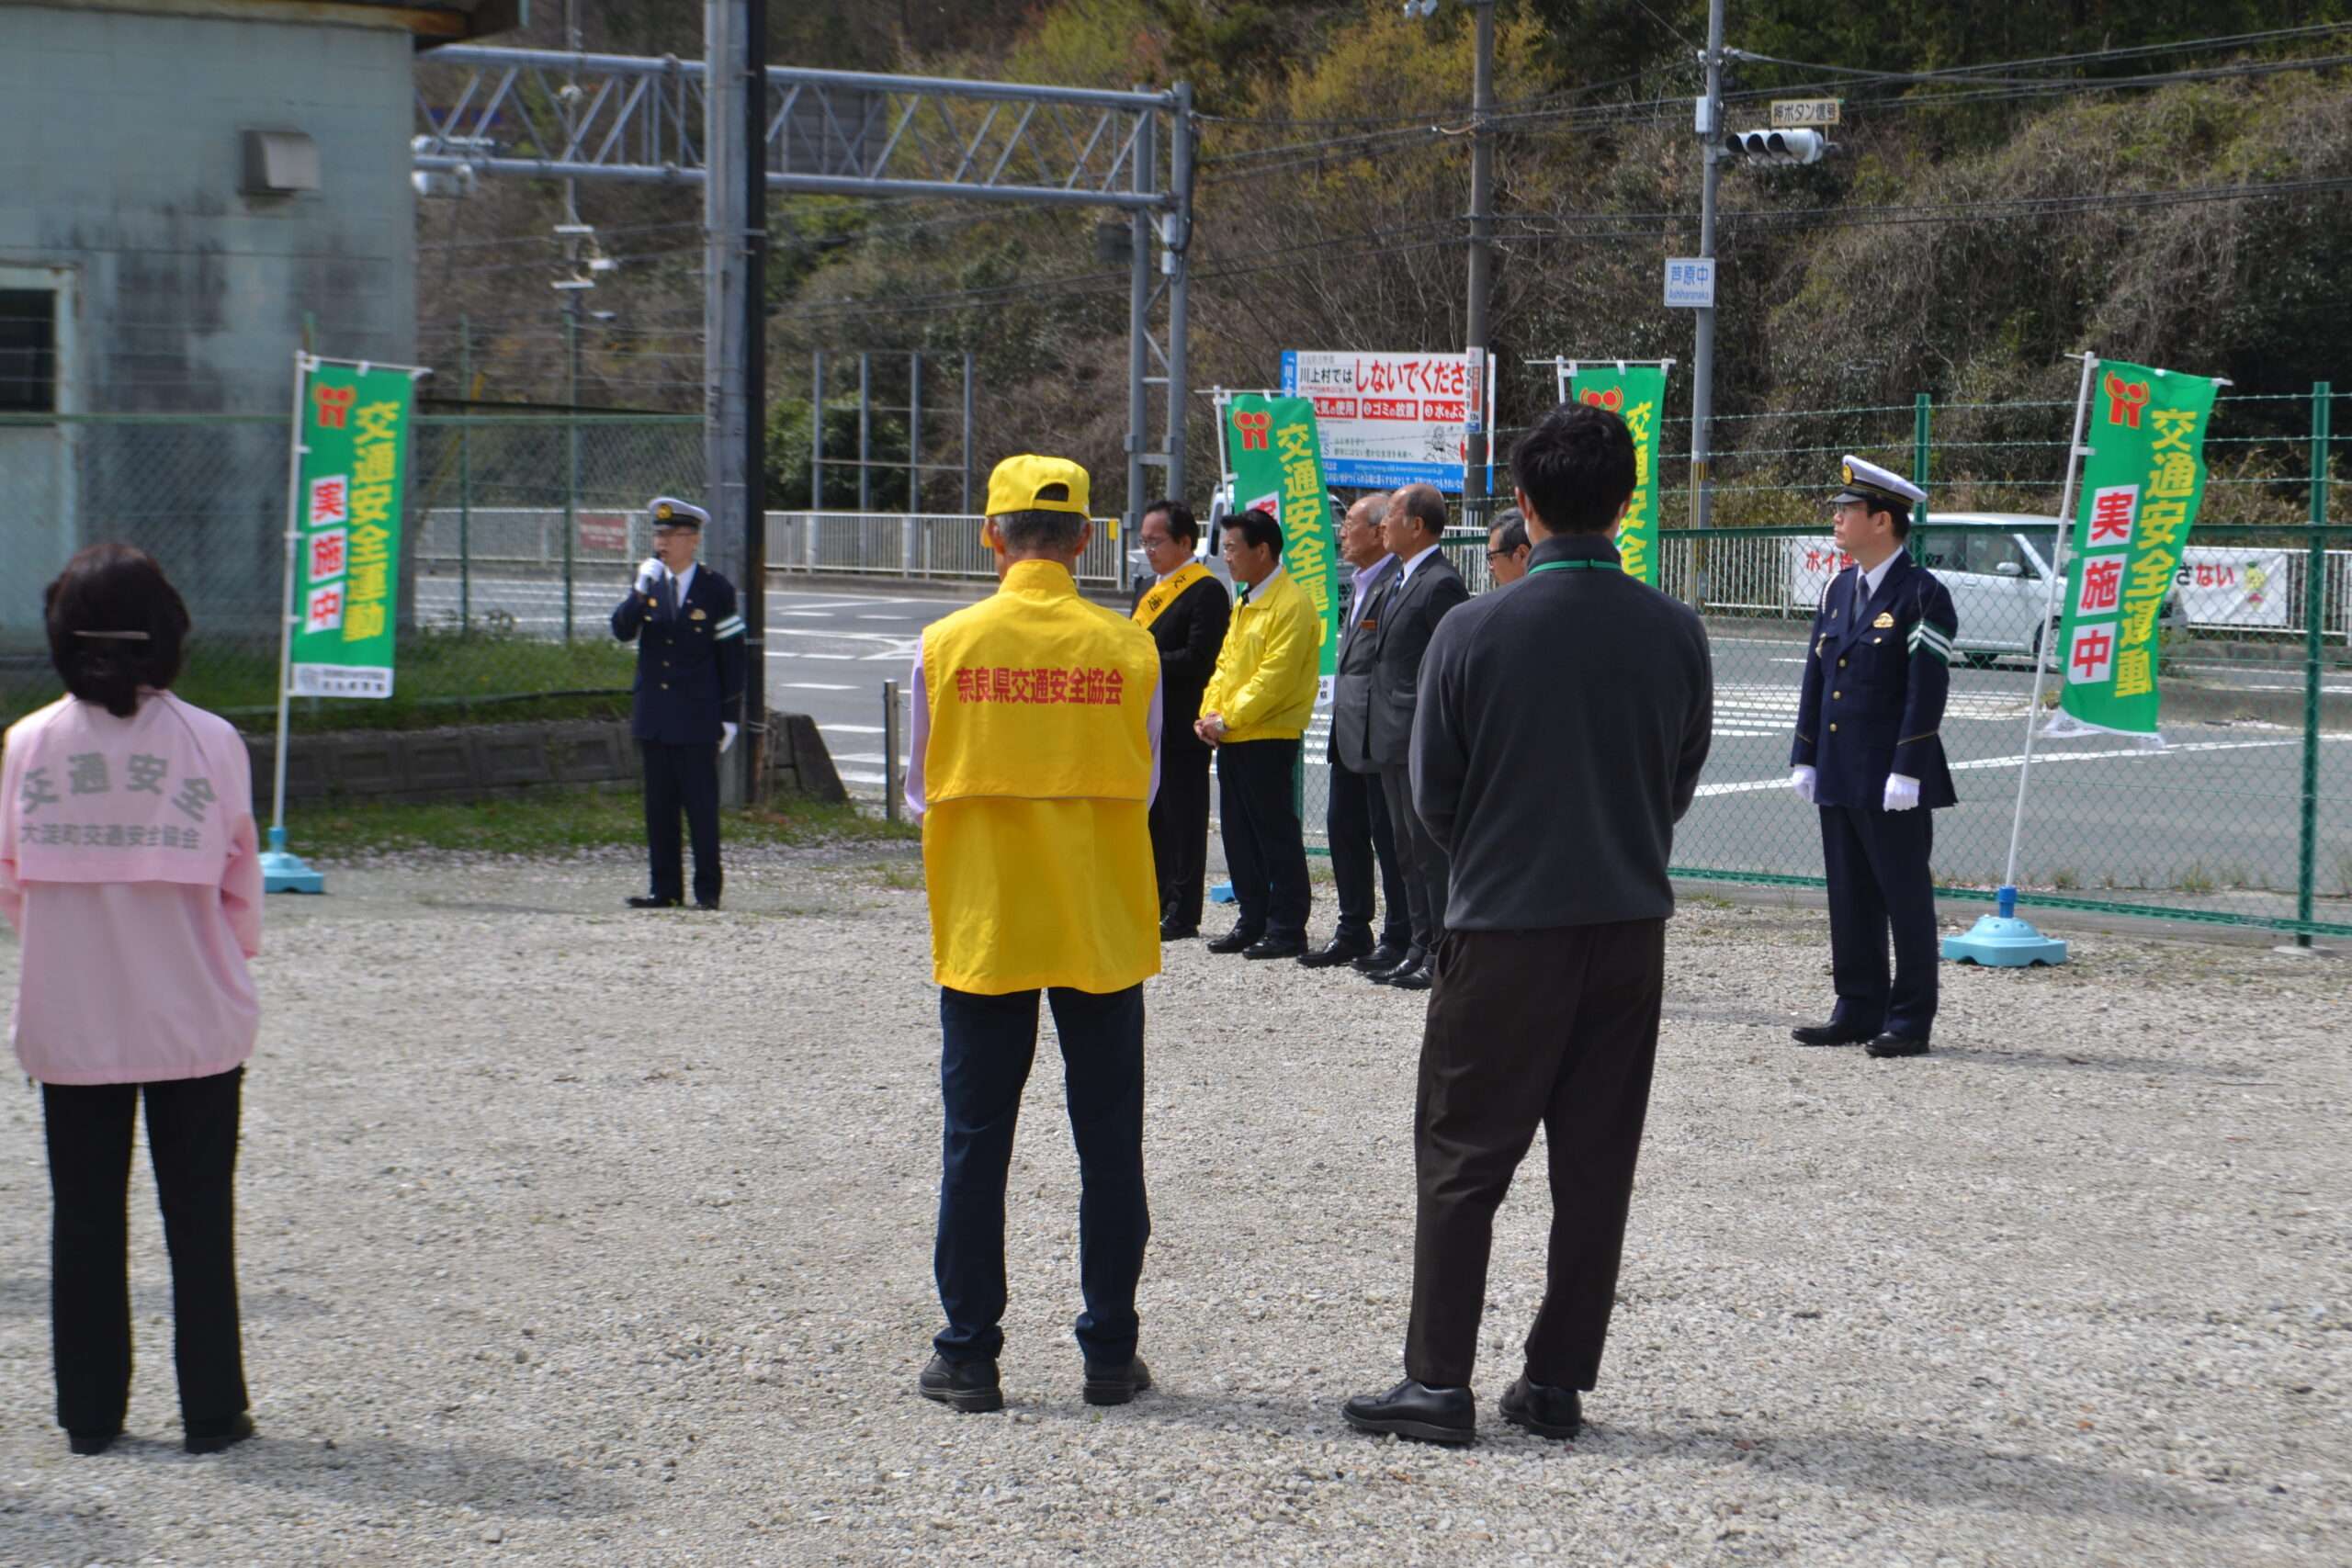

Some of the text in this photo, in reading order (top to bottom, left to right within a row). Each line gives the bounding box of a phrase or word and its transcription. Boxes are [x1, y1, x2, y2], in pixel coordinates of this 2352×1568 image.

[1774, 102, 1836, 122] 押ボタン信号
[1300, 367, 1353, 384] 川上村では
[1355, 357, 1465, 396] しないでくださ
[310, 481, 345, 626] 実施中
[343, 400, 401, 642] 交通安全運動
[2115, 408, 2198, 698] 交通安全運動
[2072, 491, 2134, 678] 実施中
[956, 667, 1124, 705] 奈良県交通安全協会
[20, 751, 217, 823] 交通安全
